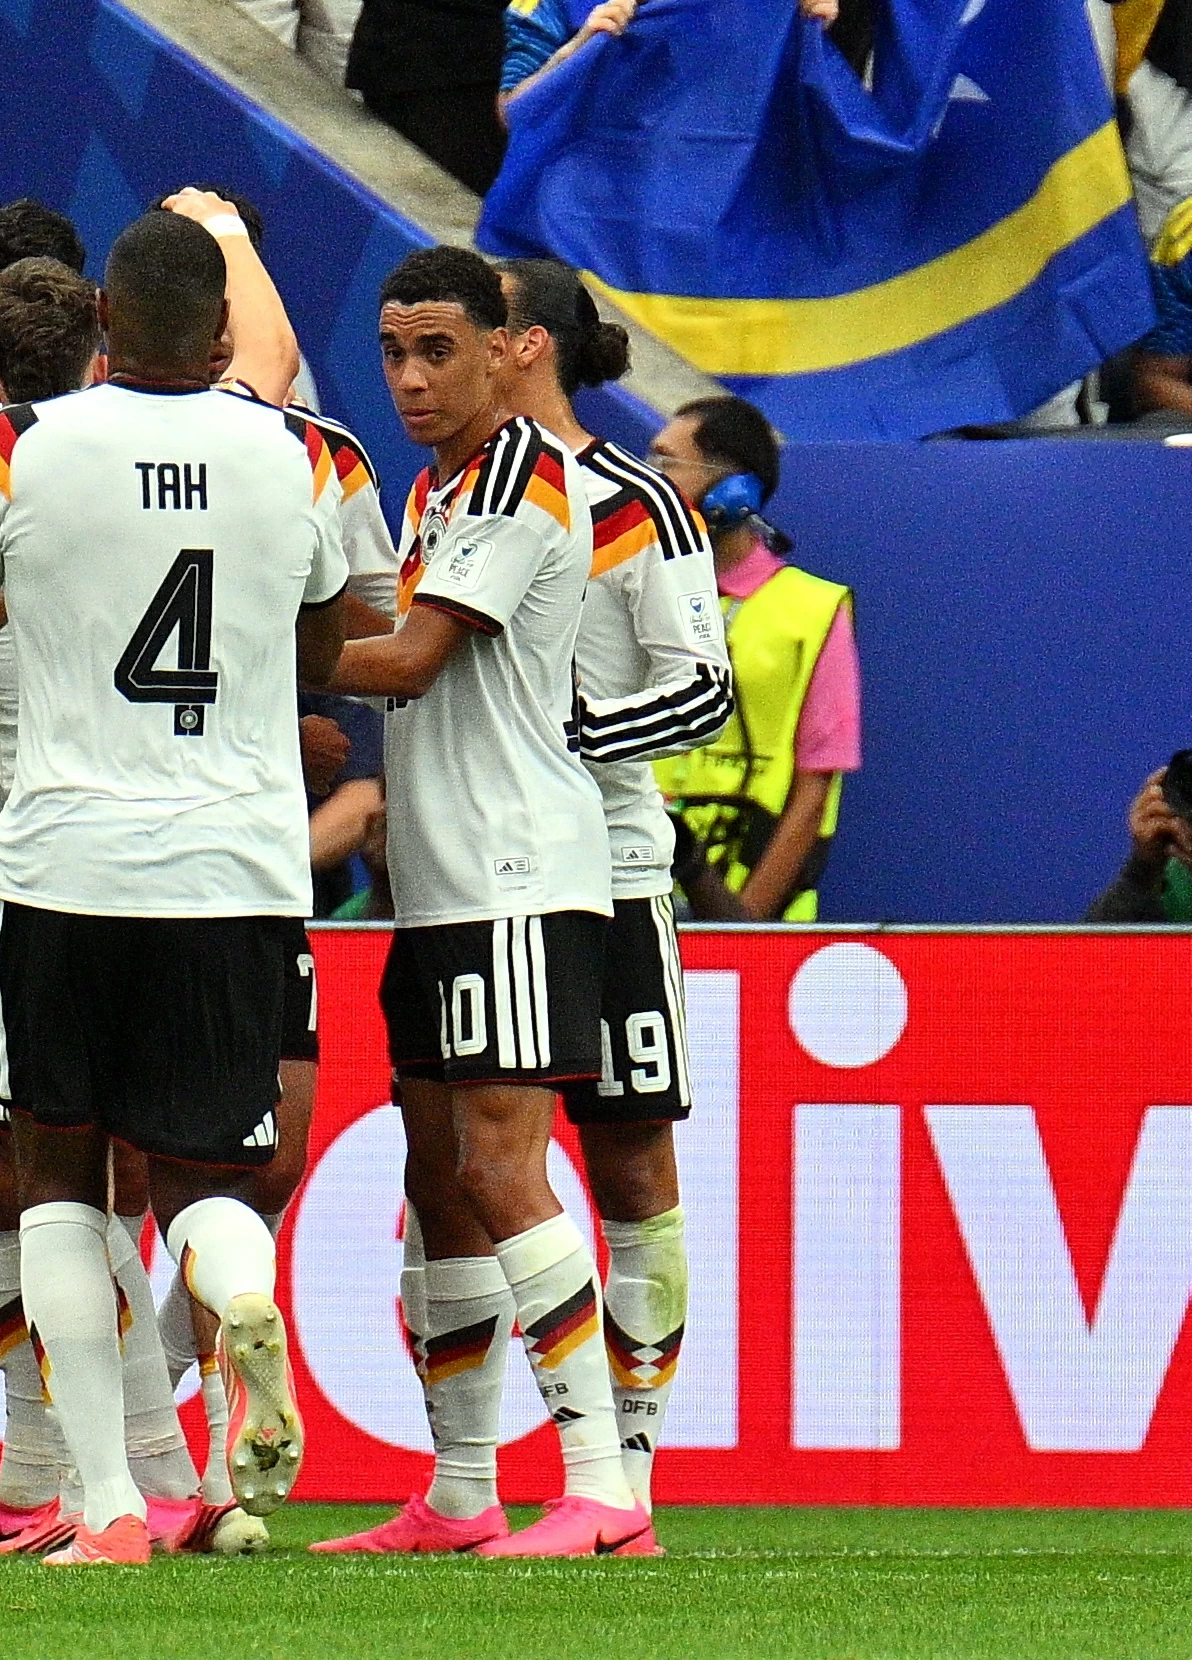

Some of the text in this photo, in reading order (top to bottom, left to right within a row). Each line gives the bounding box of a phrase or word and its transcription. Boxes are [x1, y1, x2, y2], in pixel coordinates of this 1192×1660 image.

[135, 462, 208, 510] TAH
[113, 549, 219, 736] 4
[597, 1010, 671, 1097] 19
[542, 1382, 569, 1398] FB
[622, 1399, 658, 1416] DFB
